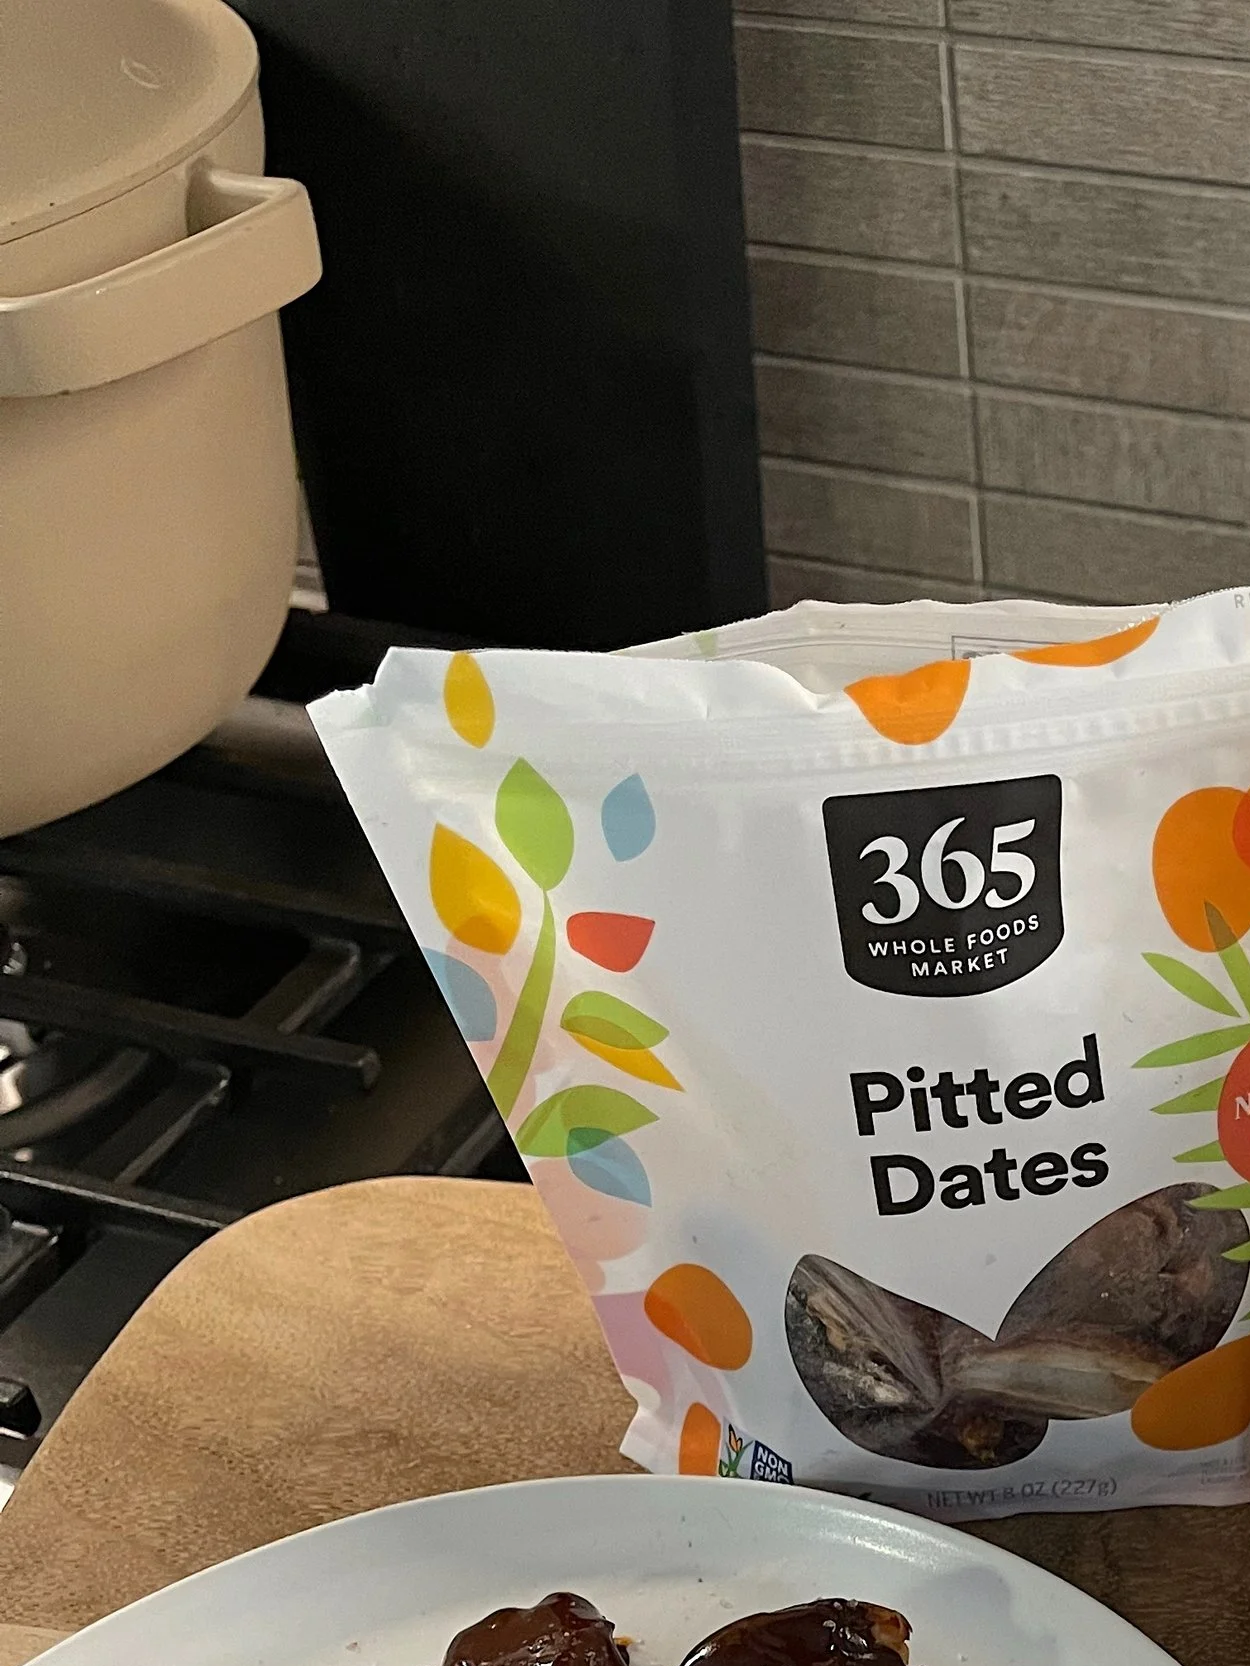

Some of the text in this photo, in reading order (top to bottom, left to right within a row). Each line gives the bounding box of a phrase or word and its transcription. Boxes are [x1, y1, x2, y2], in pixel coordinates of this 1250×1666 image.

[859, 817, 1036, 925] 365
[868, 914, 1039, 957] WHOLE FOODS
[911, 948, 1008, 977] MARKET
[850, 1033, 1106, 1137] Pitted
[870, 1141, 1110, 1217] Dates
[757, 1445, 789, 1477] NON
[927, 1490, 964, 1508] NET
[967, 1488, 996, 1506] WT
[1021, 1481, 1047, 1498] OZ
[1052, 1476, 1118, 1499] (227g)
